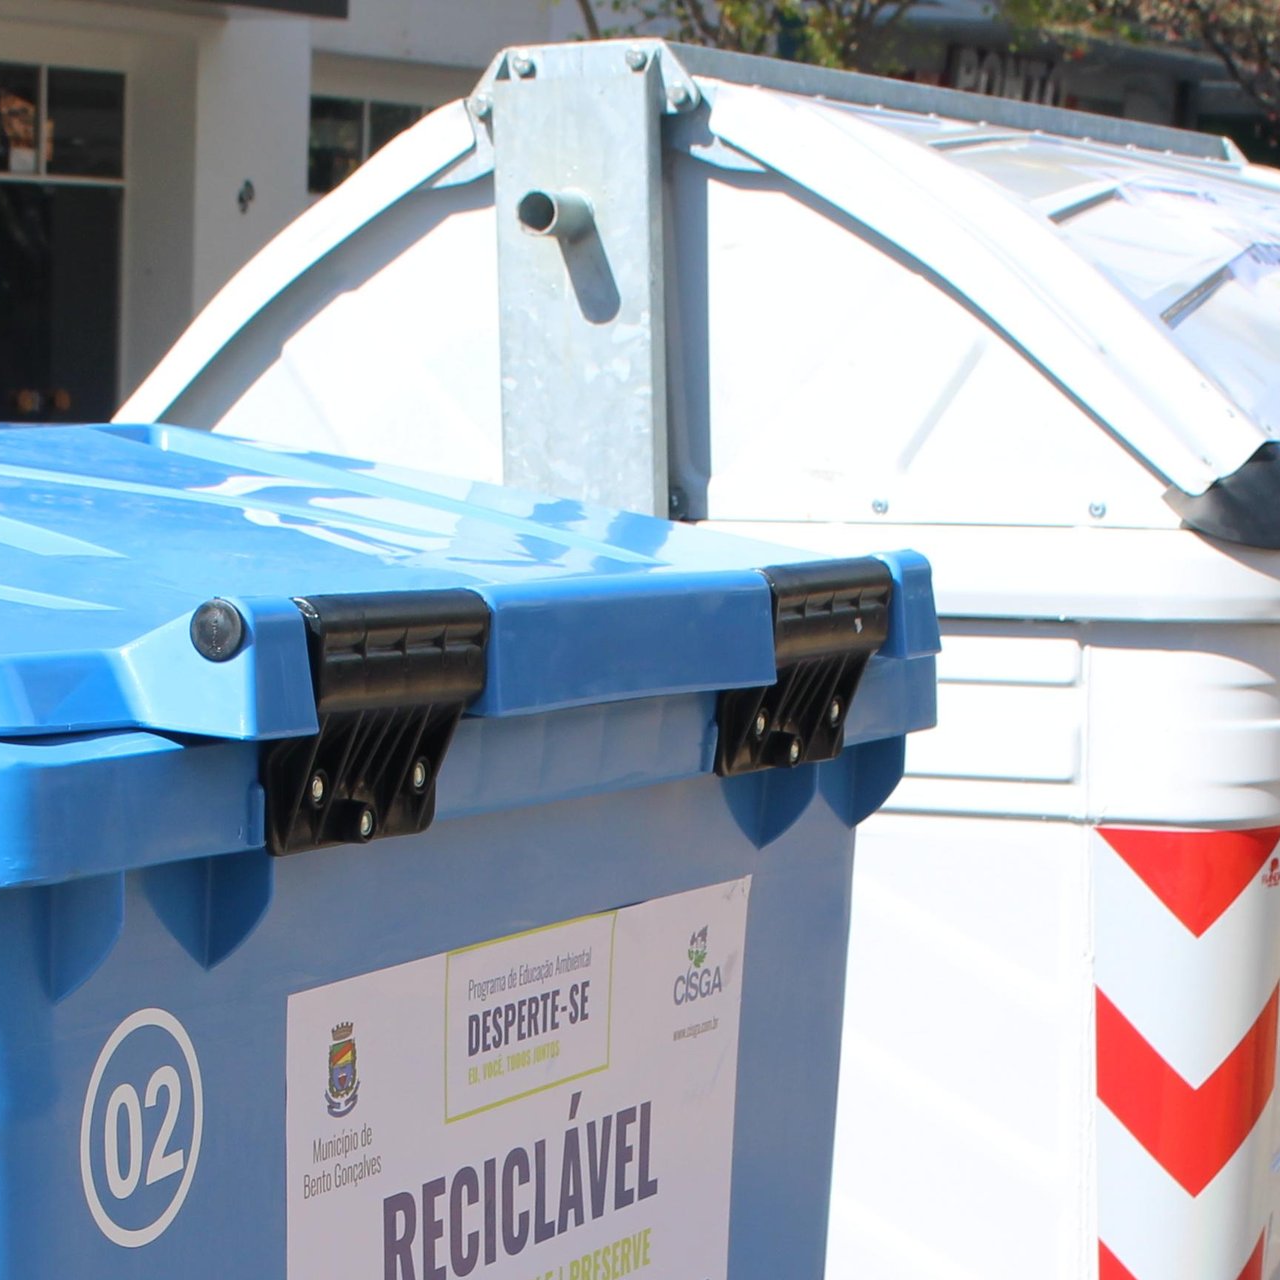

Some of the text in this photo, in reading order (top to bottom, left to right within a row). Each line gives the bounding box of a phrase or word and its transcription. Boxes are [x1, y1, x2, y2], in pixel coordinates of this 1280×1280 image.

[468, 946, 592, 1001] Programa de Educação Ambiental
[673, 963, 722, 1006] CISGA
[468, 980, 590, 1057] DESPERTE-SE
[105, 1066, 184, 1199] 02
[313, 1122, 373, 1164] Município de
[304, 1154, 382, 1199] Bento Gonçalves
